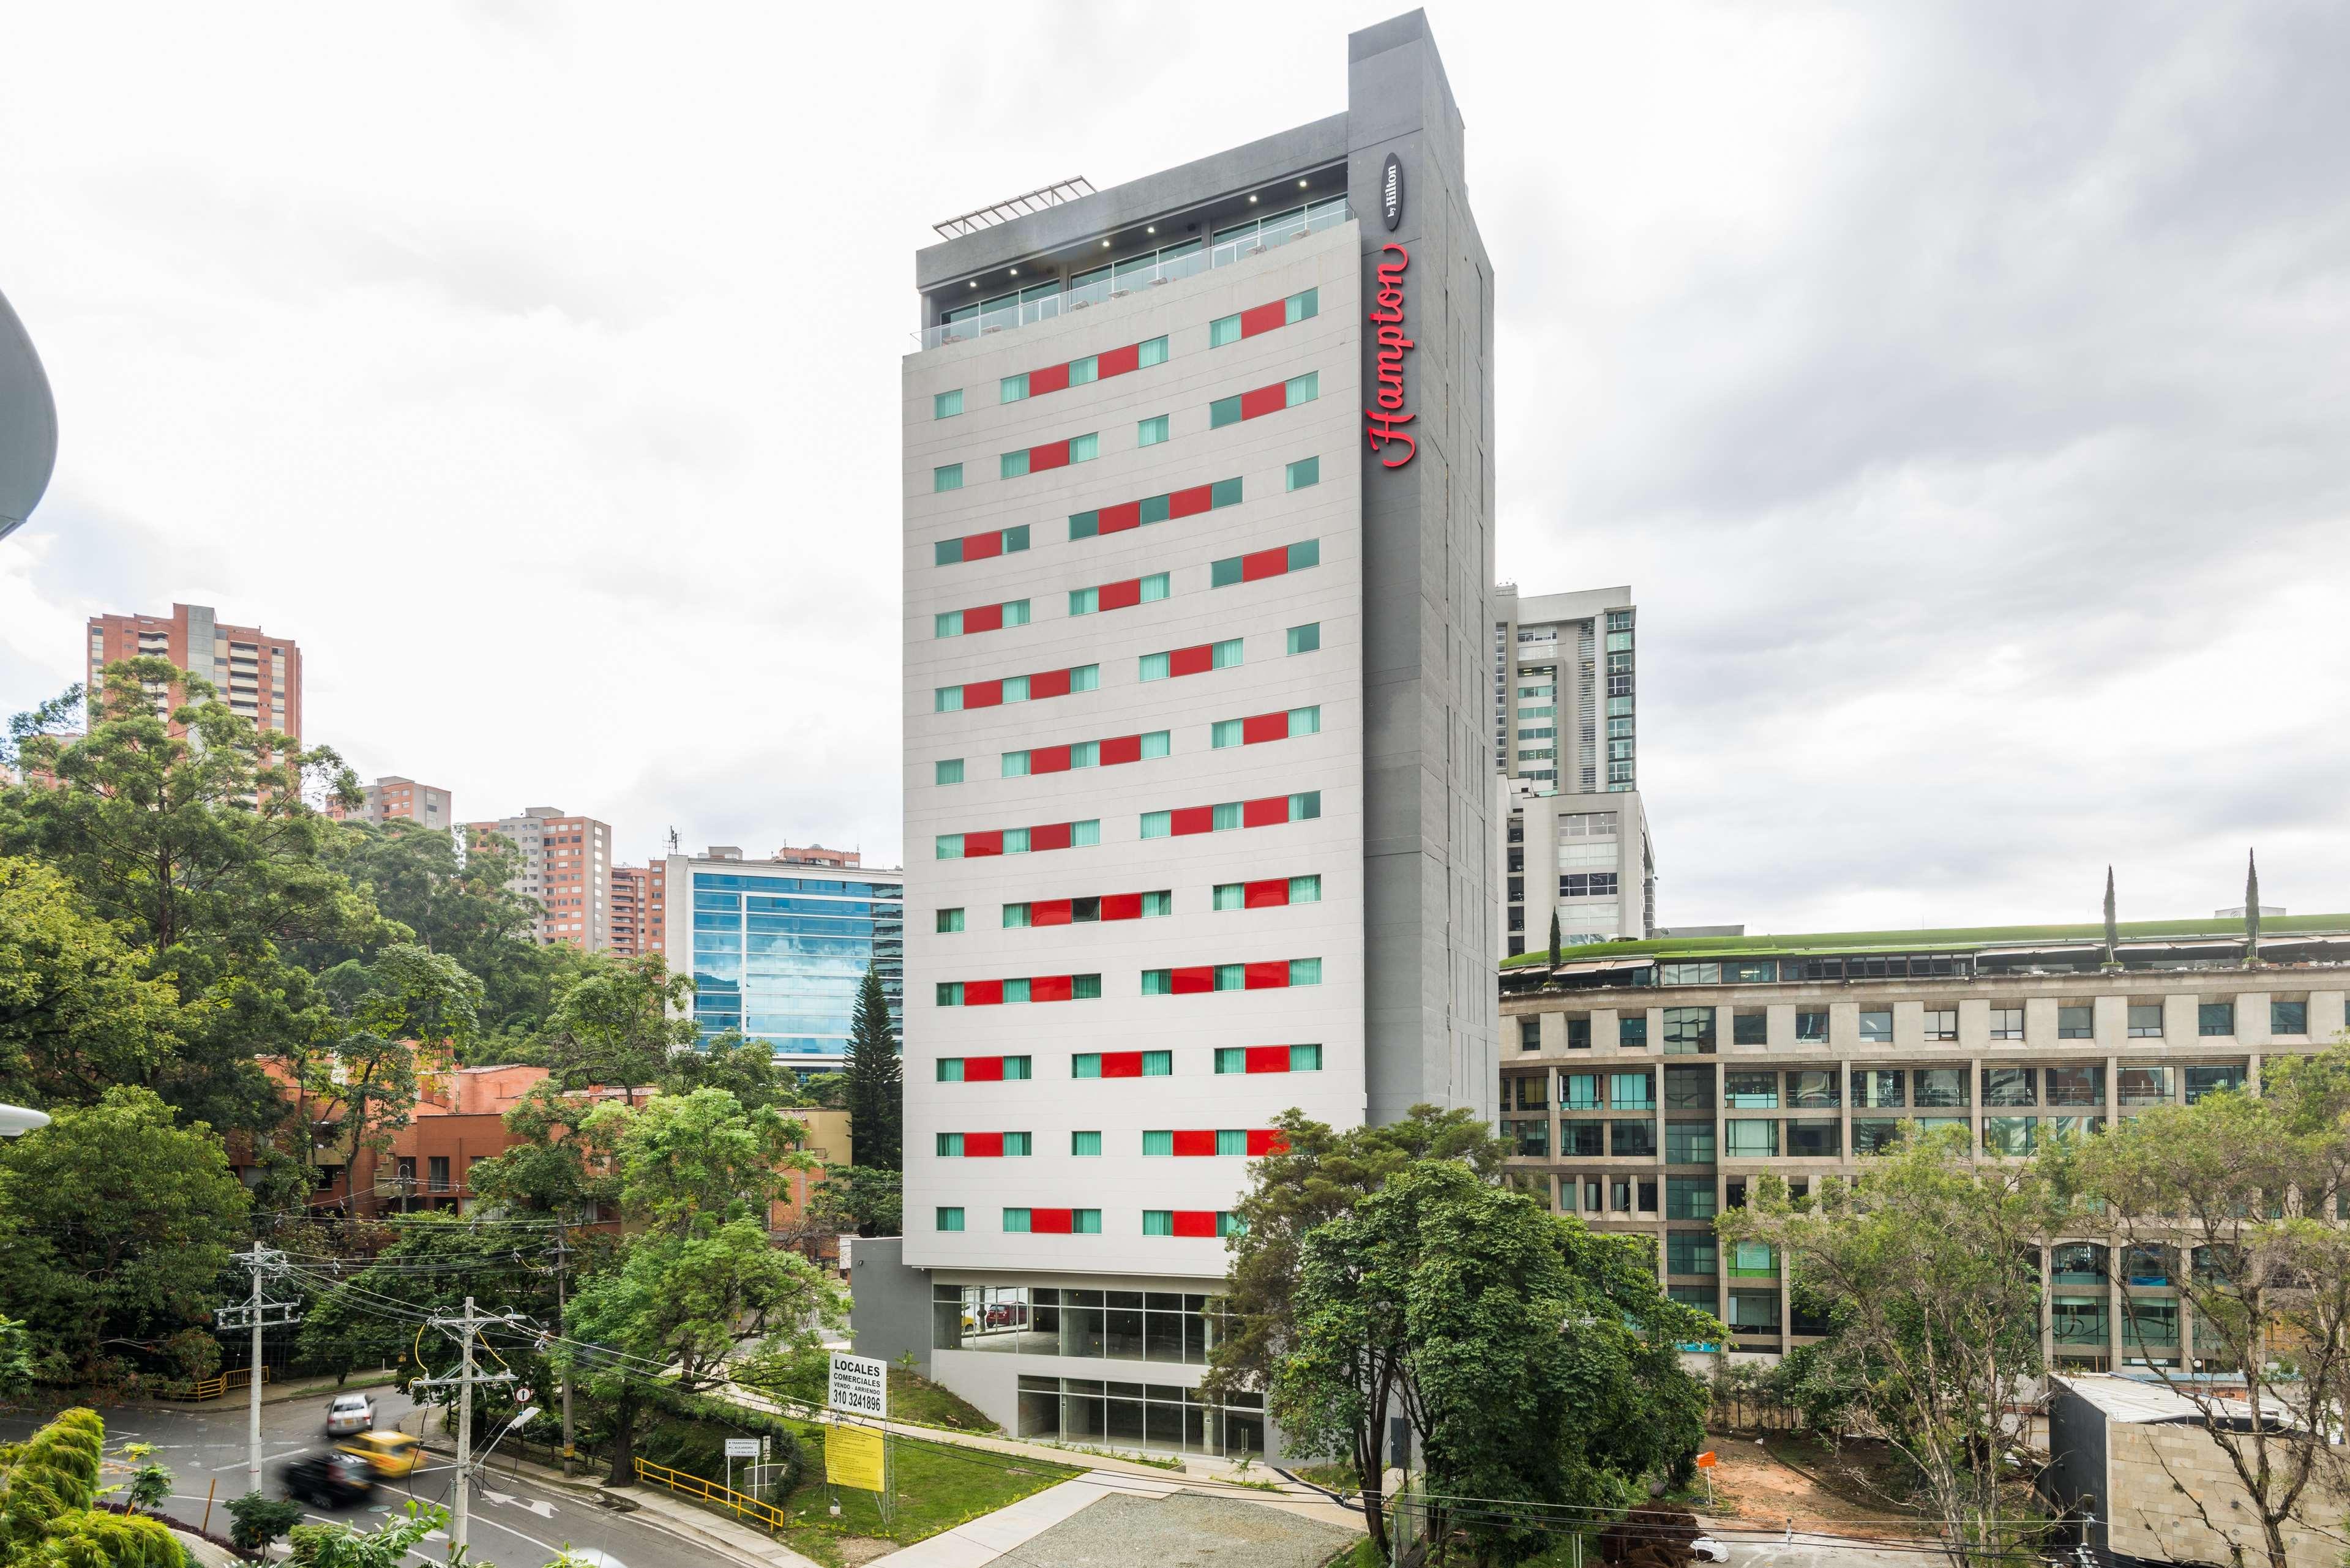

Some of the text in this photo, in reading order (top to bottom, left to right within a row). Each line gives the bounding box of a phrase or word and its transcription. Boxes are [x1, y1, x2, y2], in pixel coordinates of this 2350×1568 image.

[1385, 164, 1396, 217] by Hilton
[1366, 242, 1416, 467] Hampton
[834, 1359, 880, 1377] LOCALES
[834, 1372, 880, 1387] COMERCIALES
[833, 1389, 880, 1411] 310 3241896
[854, 1386, 880, 1395] ARRIENDO
